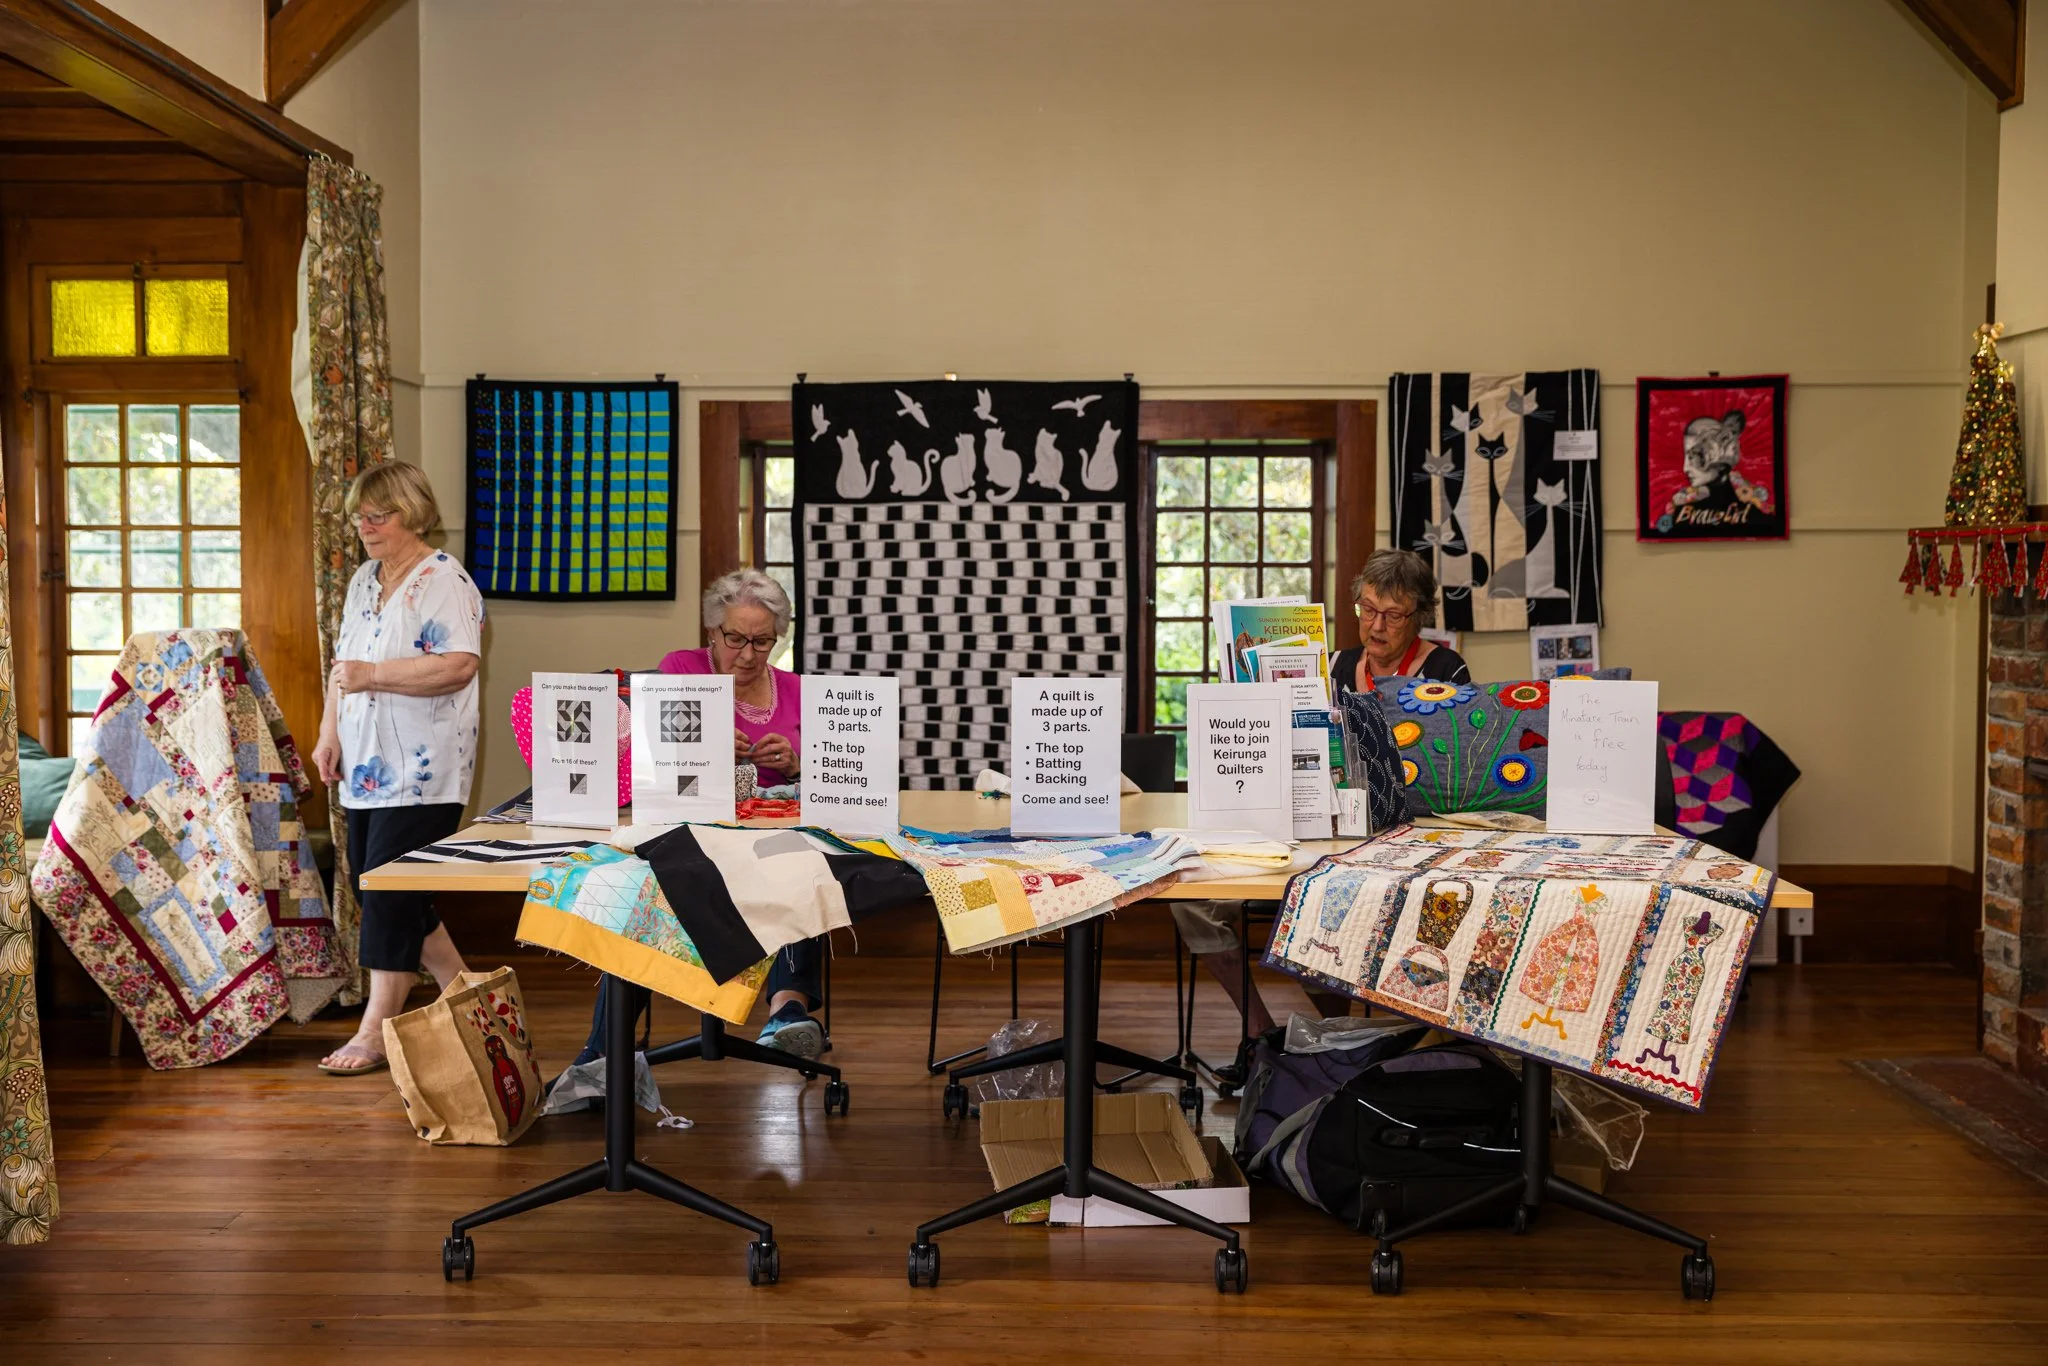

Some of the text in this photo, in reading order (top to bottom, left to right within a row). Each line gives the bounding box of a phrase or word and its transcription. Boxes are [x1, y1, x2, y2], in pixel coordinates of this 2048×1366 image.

[1264, 625, 1324, 635] KEIRUNGA
[825, 689, 875, 702] A quilt is
[1039, 690, 1095, 703] A quilt is
[1579, 692, 1601, 705] The
[818, 705, 882, 719] made up of
[1031, 706, 1104, 719] made up of
[1609, 710, 1640, 725] Train
[828, 720, 871, 733] 3 parts.
[1042, 721, 1091, 734] 3 parts.
[1209, 718, 1270, 731] Would you
[1210, 733, 1270, 746] like to join
[1574, 732, 1582, 741] is
[1593, 728, 1627, 751] free
[822, 741, 865, 756] The top
[1035, 742, 1084, 755] The top
[1213, 749, 1267, 761] Keirunga
[822, 757, 863, 772] Batting
[1035, 758, 1082, 771] Batting
[1217, 764, 1264, 775] Quilters
[1576, 756, 1608, 783] today
[822, 772, 868, 788] Backing
[1035, 773, 1087, 787] Backing
[1235, 779, 1245, 793] ?
[810, 793, 888, 807] Come and see!
[1022, 794, 1109, 805] Come and see!
